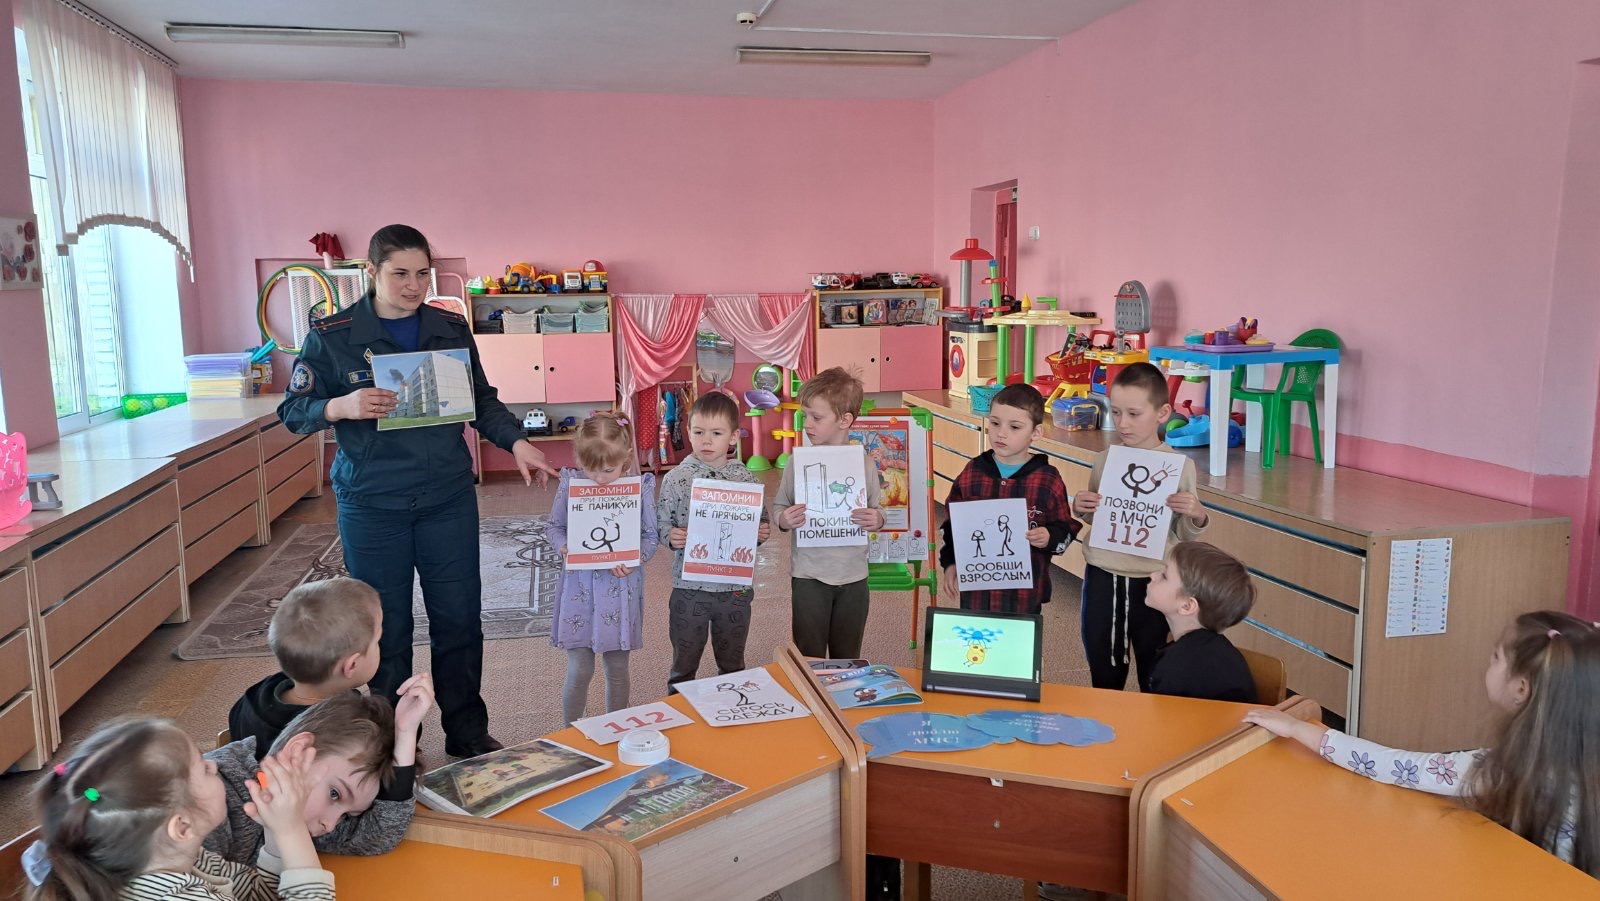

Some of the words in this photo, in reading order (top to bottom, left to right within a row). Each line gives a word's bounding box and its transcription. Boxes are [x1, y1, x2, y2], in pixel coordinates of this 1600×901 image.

[579, 486, 633, 496] ЗАПОМНИ!
[701, 491, 755, 504] ЗАПОМНИ!
[572, 503, 584, 511] НЕ
[588, 500, 638, 511] ПАНИКУЙ!
[701, 502, 717, 510] ПРИ
[720, 504, 751, 513] ПОЖАРЕ
[1104, 496, 1164, 515] ПОЗВОНИ
[695, 509, 707, 518] НЕ
[711, 510, 755, 522] ПРЯЧЬСЯ!
[1120, 511, 1158, 529] МЧС
[799, 527, 866, 539] ПОМЕЩЕНИЕ
[1107, 522, 1150, 549] 112
[706, 565, 726, 573] ПУНКТ
[965, 561, 1023, 573] СООБЩИ
[960, 571, 1031, 583] ВЗРОСЛЫМ
[715, 706, 794, 721] ОДЕЖДУ
[717, 702, 785, 714] СБРОСЬ
[604, 711, 674, 734] 112
